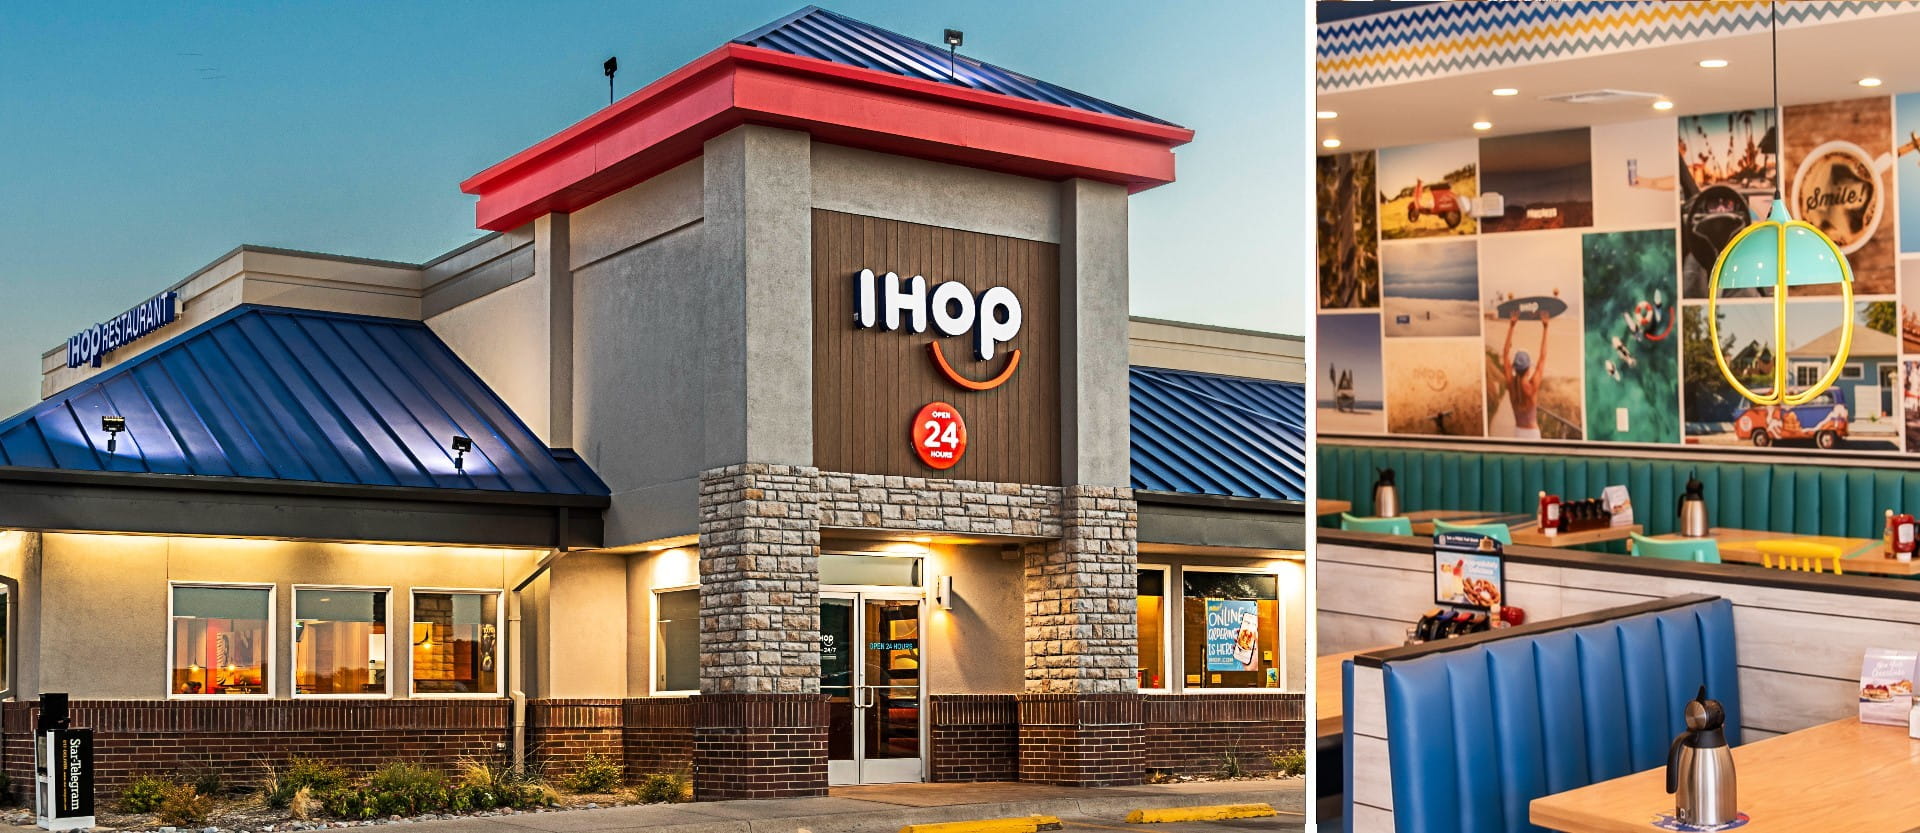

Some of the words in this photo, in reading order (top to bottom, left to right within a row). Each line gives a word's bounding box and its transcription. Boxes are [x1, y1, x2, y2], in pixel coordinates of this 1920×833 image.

[1806, 184, 1865, 213] Smile!
[102, 291, 168, 352] RESTAURANT
[859, 268, 1022, 361] IHOP
[924, 420, 959, 449] 24
[930, 451, 953, 459] HOURS
[1208, 606, 1244, 627] ONLINE
[869, 642, 885, 650] OPEN
[885, 642, 893, 650] 24
[893, 642, 913, 650] HOURS
[1208, 643, 1216, 656] IS
[69, 738, 82, 810] Star-Telegram
